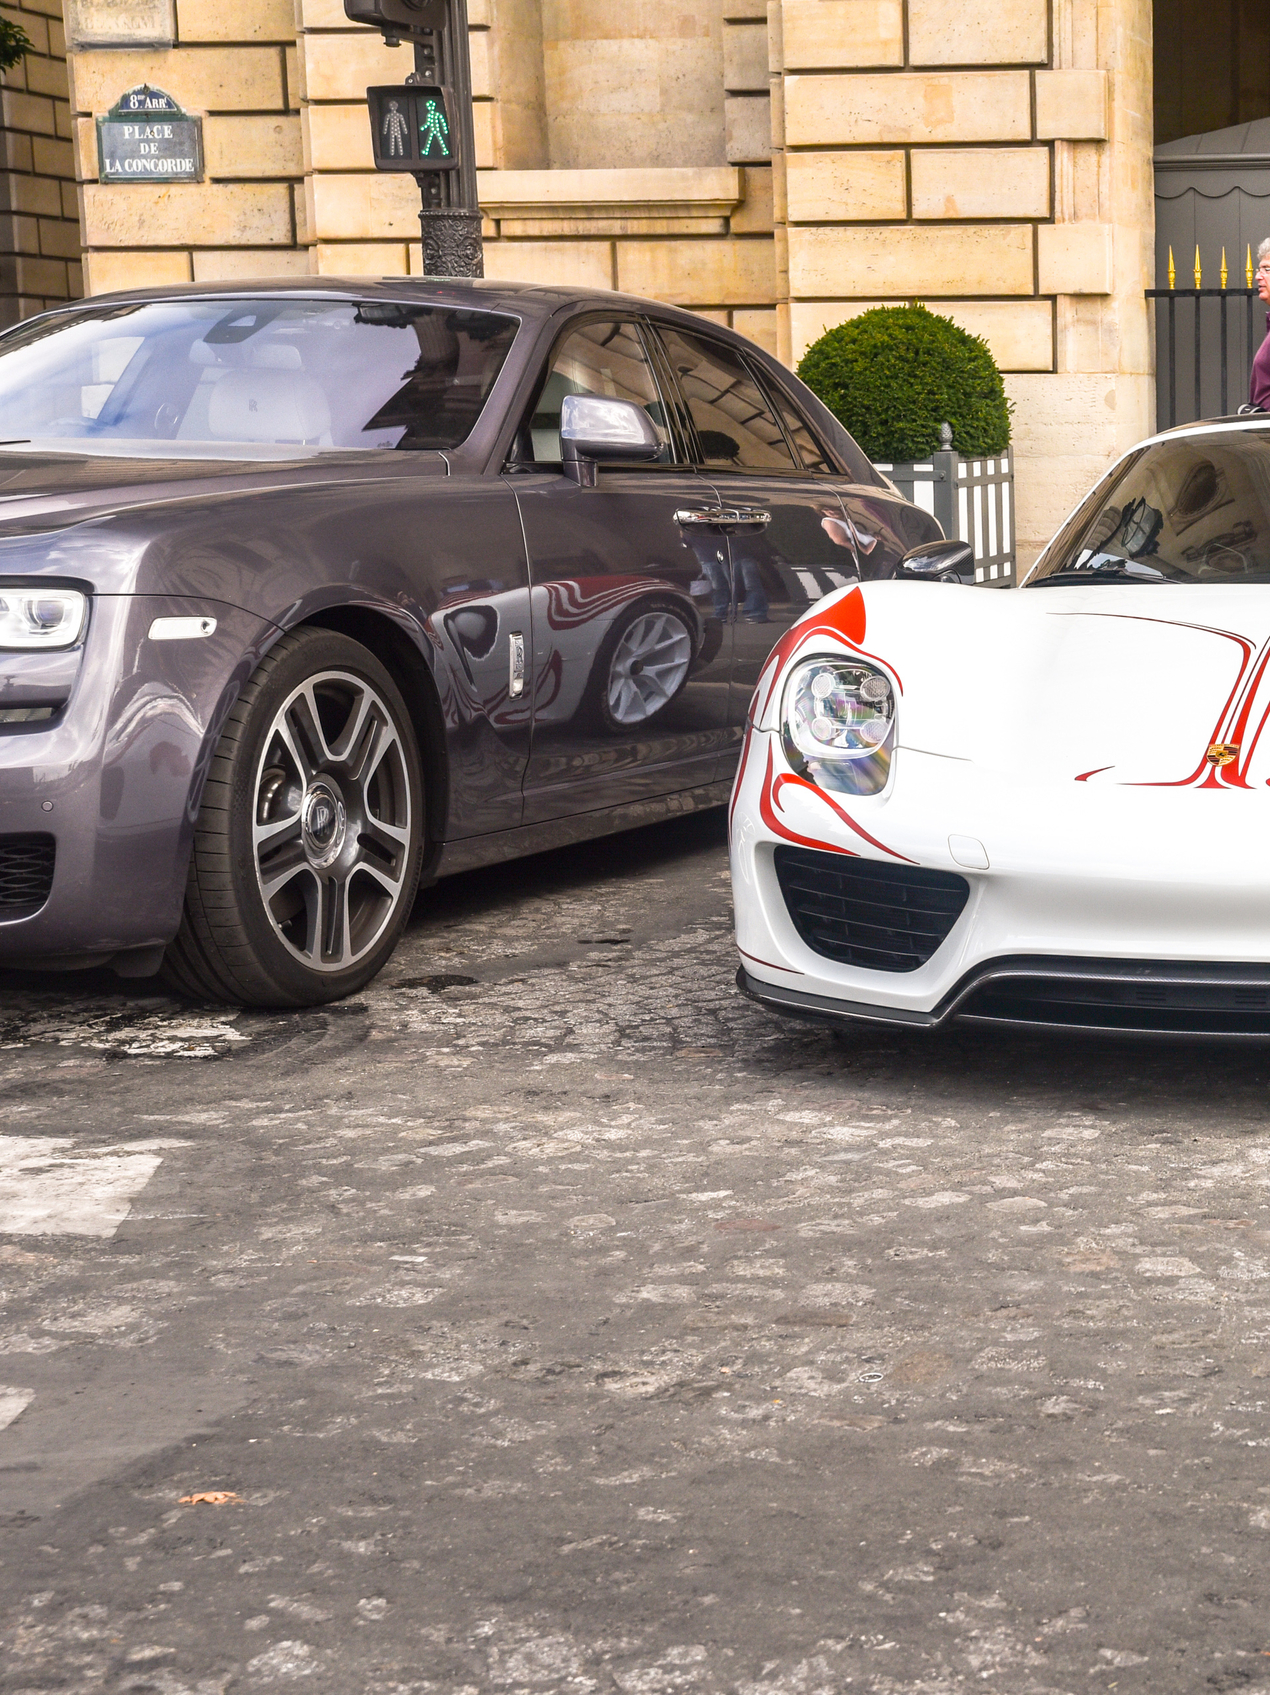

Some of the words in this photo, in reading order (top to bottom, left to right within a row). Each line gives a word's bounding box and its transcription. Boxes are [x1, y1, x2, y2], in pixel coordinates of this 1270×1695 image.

[124, 126, 173, 139] PLACE
[139, 142, 159, 155] DE
[105, 159, 123, 173] LA
[124, 158, 195, 173] CONCORDE
